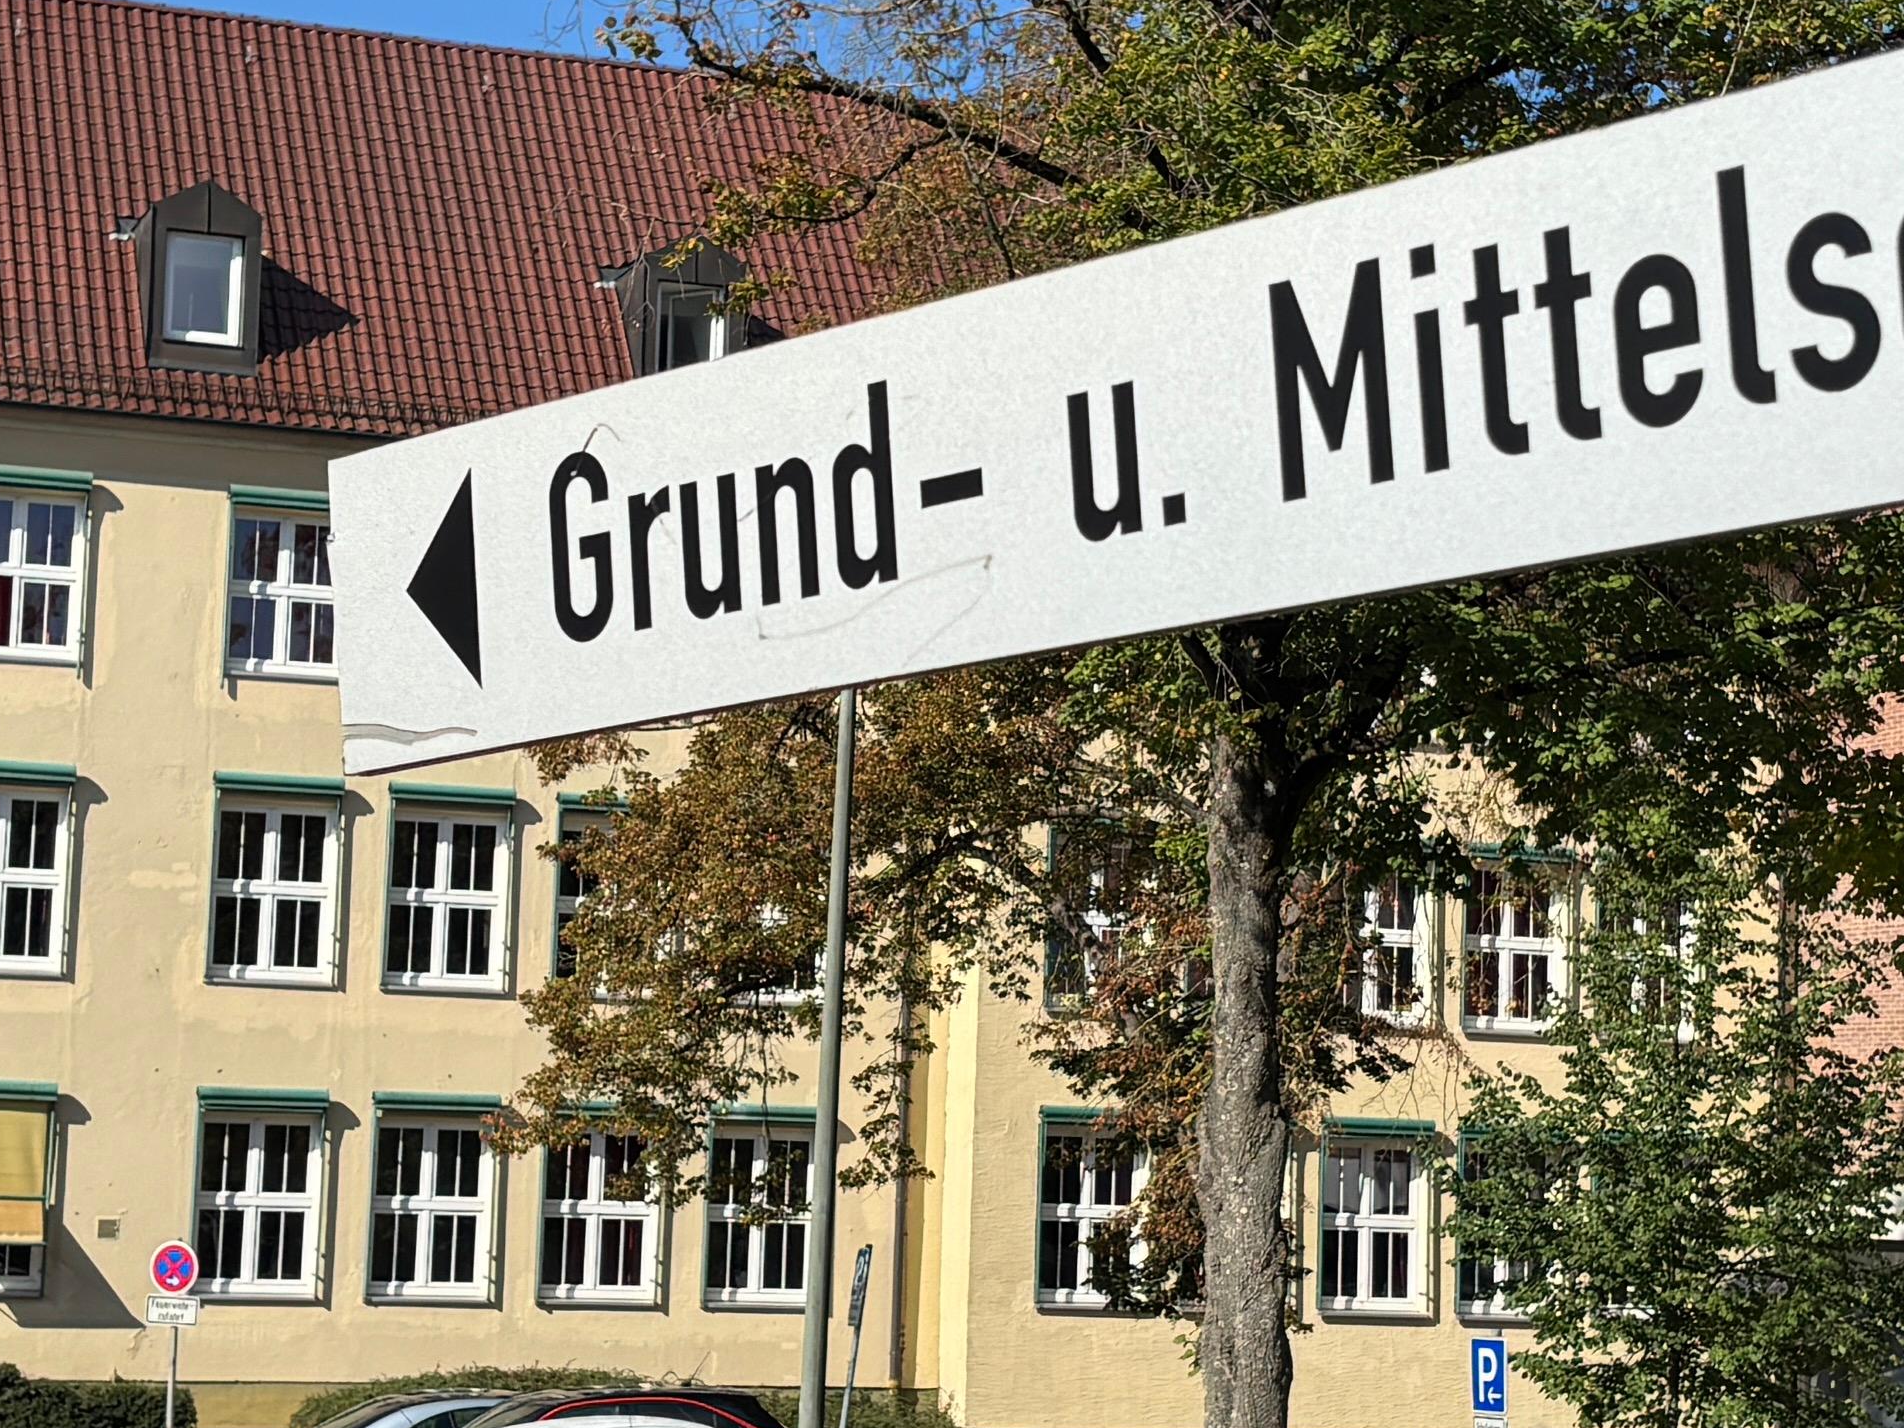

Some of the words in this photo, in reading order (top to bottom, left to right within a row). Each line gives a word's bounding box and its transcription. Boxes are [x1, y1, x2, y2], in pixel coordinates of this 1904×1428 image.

[549, 380, 984, 643] Grund-
[1066, 380, 1187, 543] u.
[1478, 1347, 1498, 1403] P
